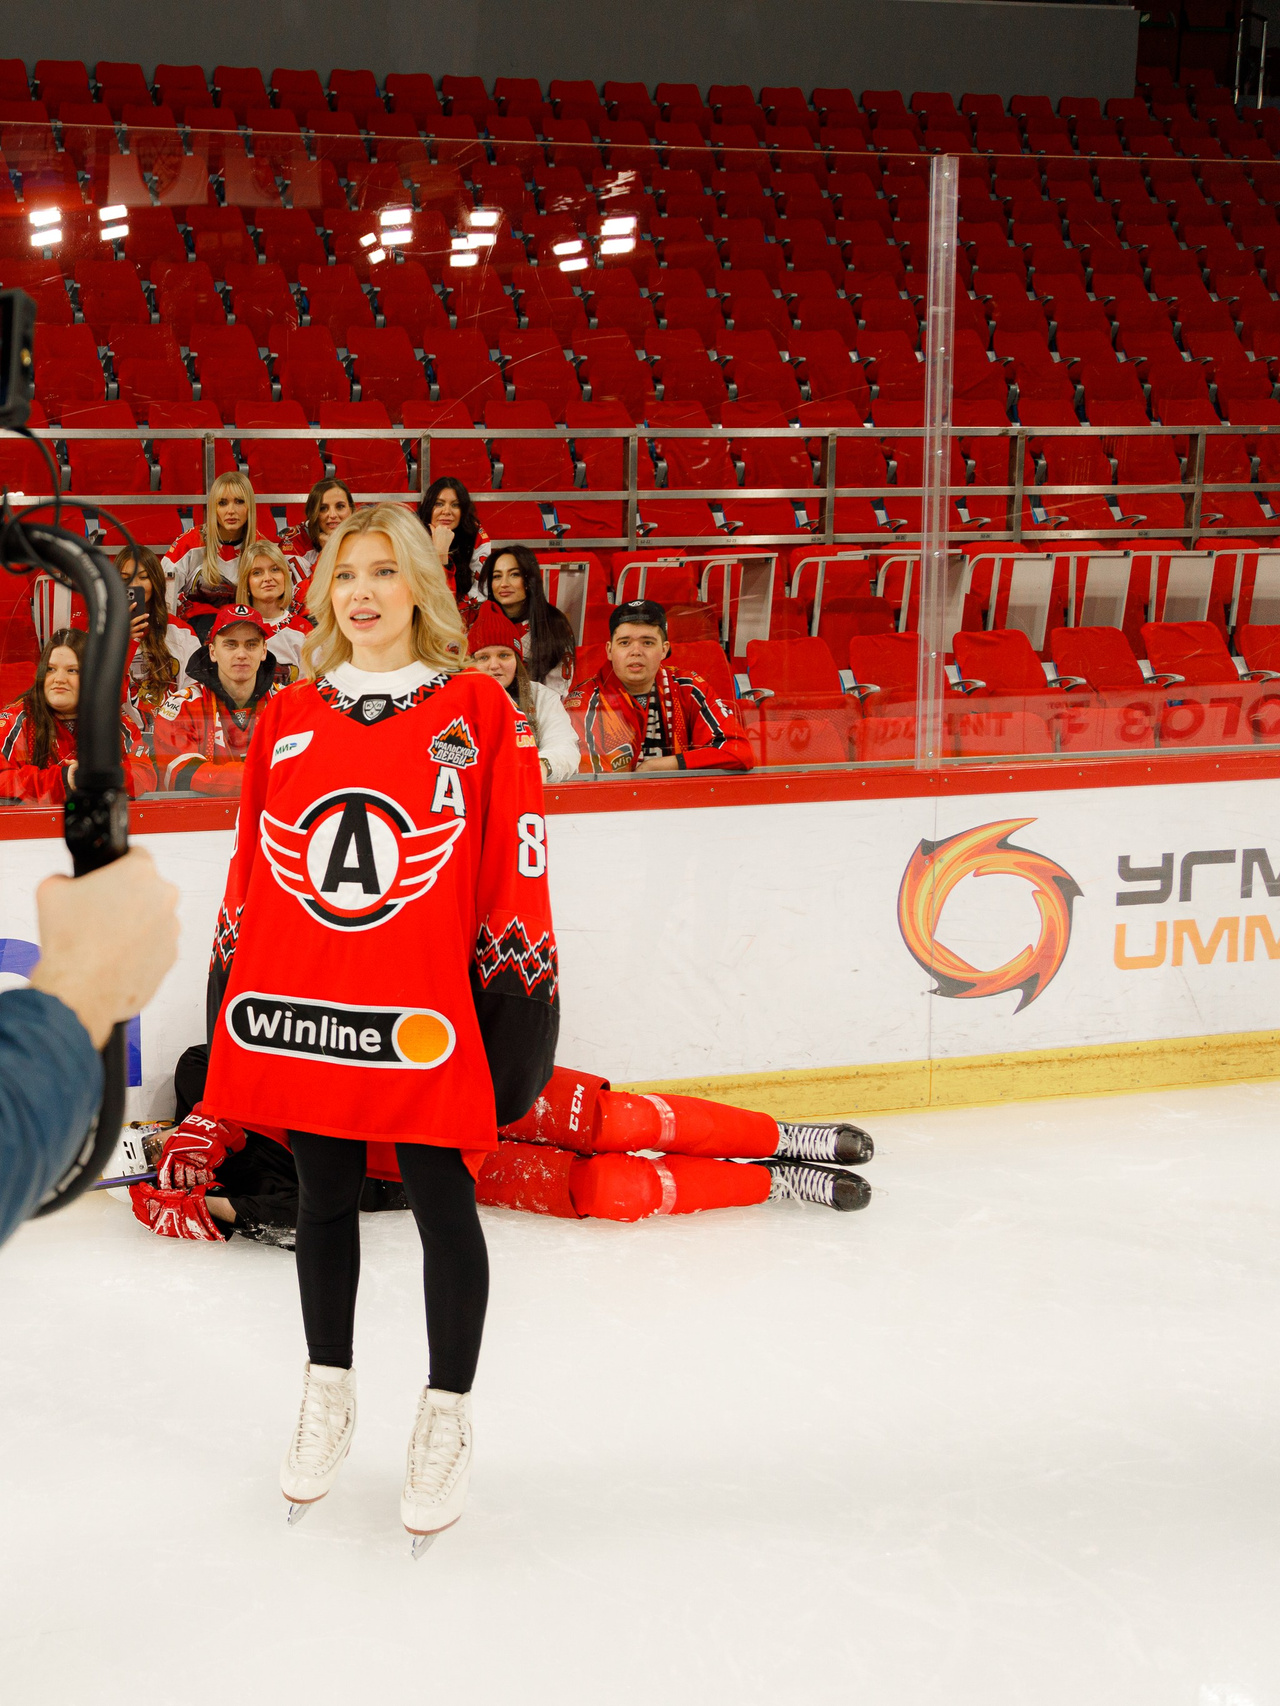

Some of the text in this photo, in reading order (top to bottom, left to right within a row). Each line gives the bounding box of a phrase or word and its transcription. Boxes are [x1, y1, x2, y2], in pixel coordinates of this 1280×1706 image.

[275, 742, 298, 756] МИР
[434, 739, 476, 757] УРАЛЬСКОЕ
[435, 749, 467, 766] ДЕРБИ
[429, 765, 467, 818] A
[320, 793, 382, 895] A
[246, 1005, 383, 1054] Winline
[568, 1083, 586, 1132] CCM
